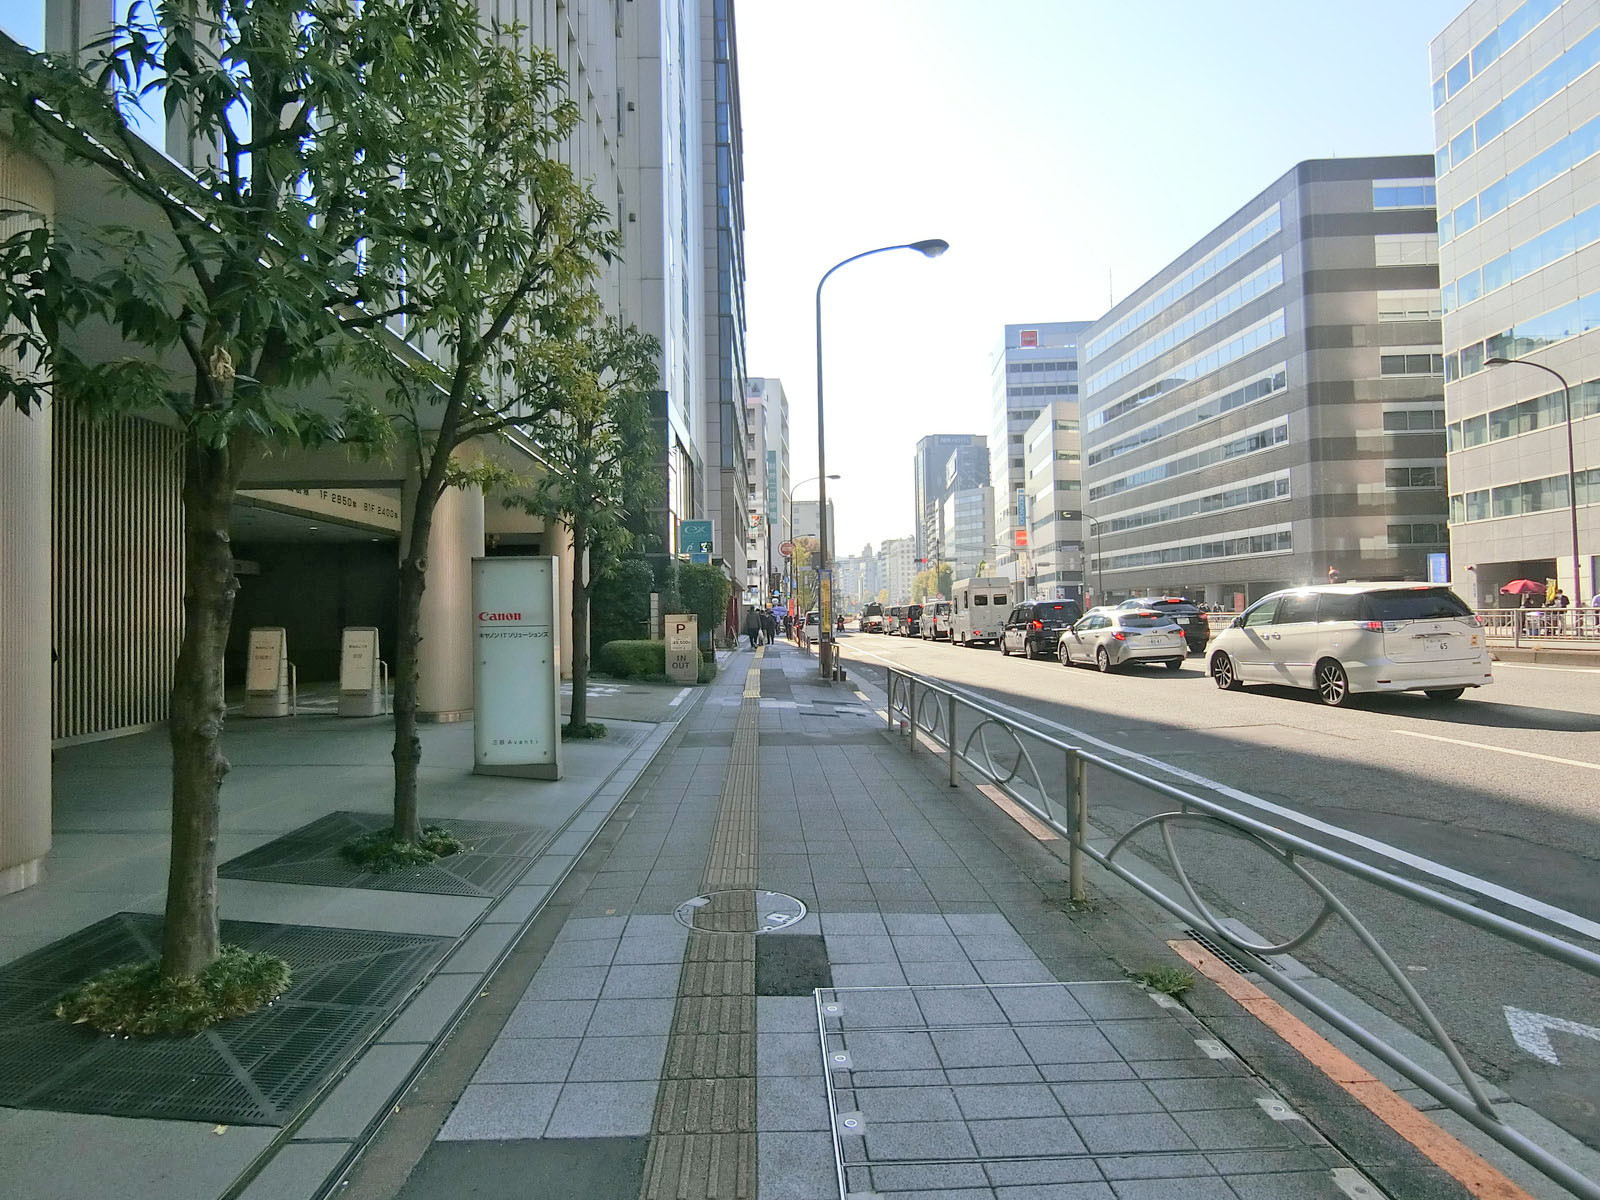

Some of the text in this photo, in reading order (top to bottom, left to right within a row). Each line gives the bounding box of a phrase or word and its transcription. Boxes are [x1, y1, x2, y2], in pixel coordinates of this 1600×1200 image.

[319, 489, 328, 500] 1F
[479, 611, 521, 621] Canon
[676, 623, 686, 635] P
[671, 662, 690, 670] OUT
